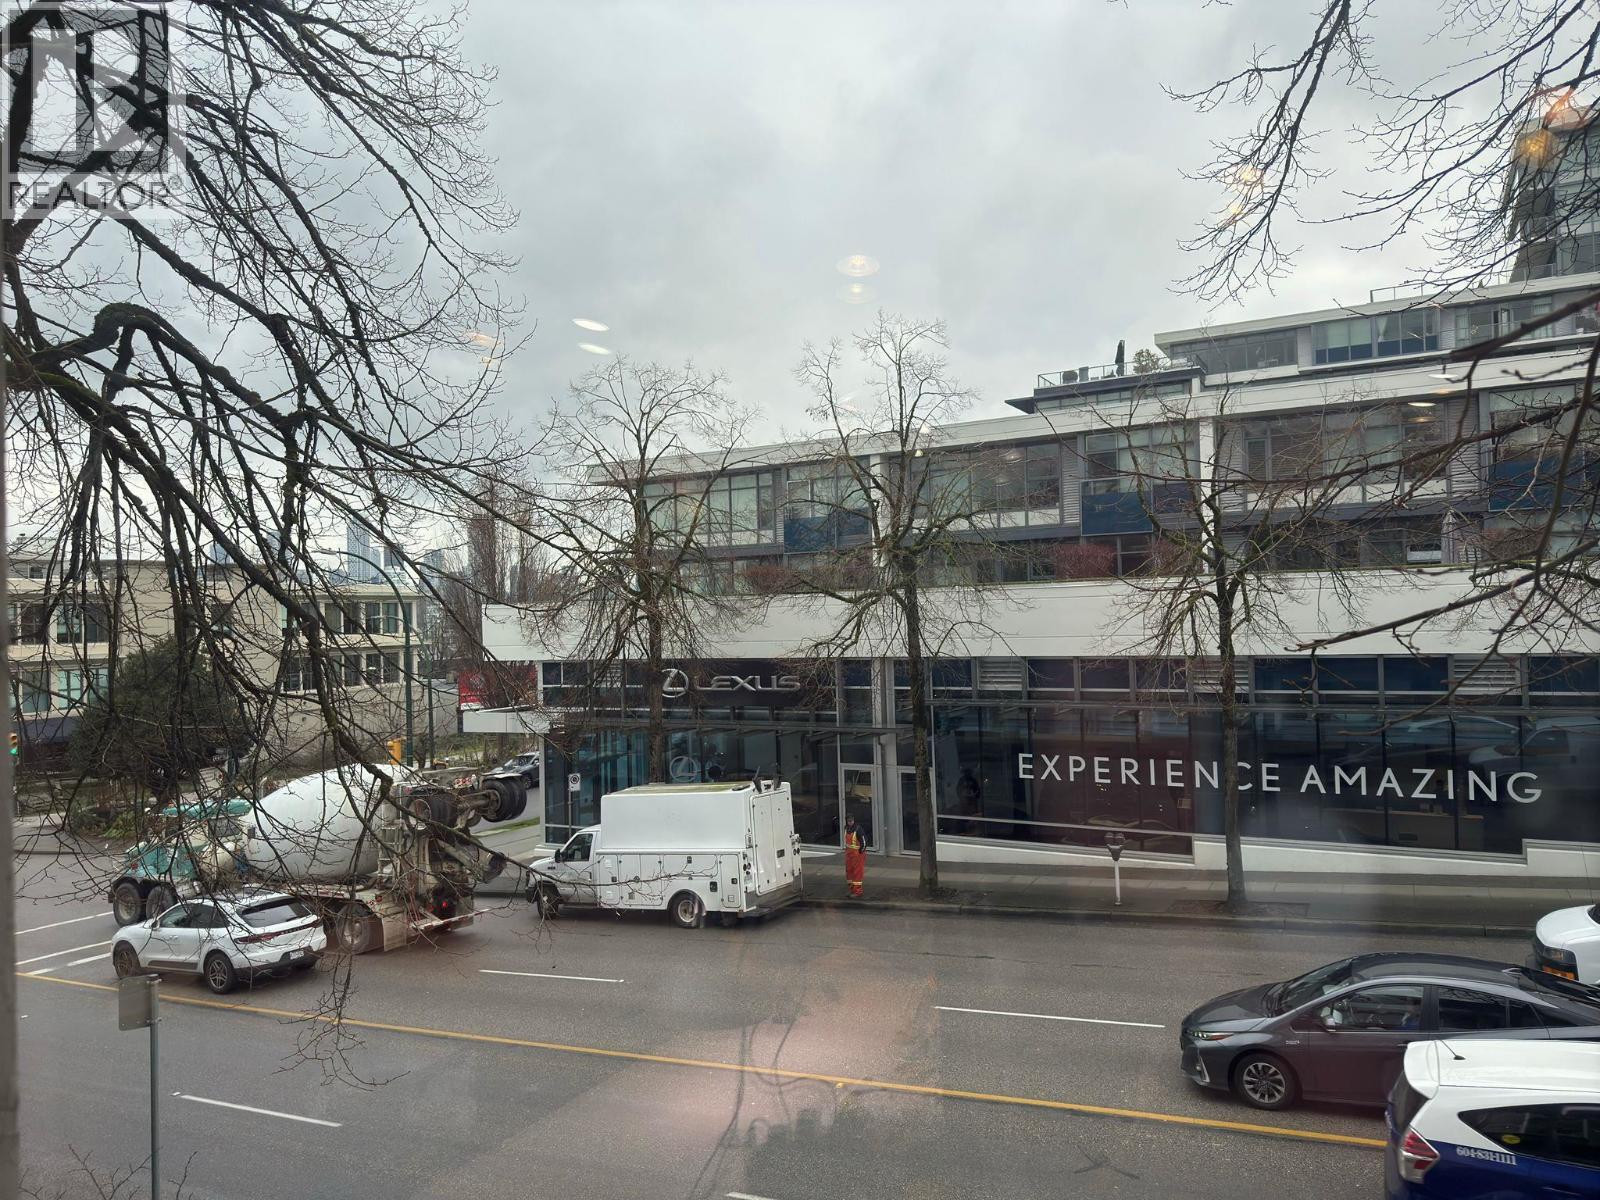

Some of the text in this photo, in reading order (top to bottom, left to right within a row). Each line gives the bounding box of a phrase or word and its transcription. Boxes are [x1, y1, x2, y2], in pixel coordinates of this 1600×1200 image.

[695, 675, 800, 691] LEXUS
[1018, 752, 1542, 803] EXPERIENCE AMAZING
